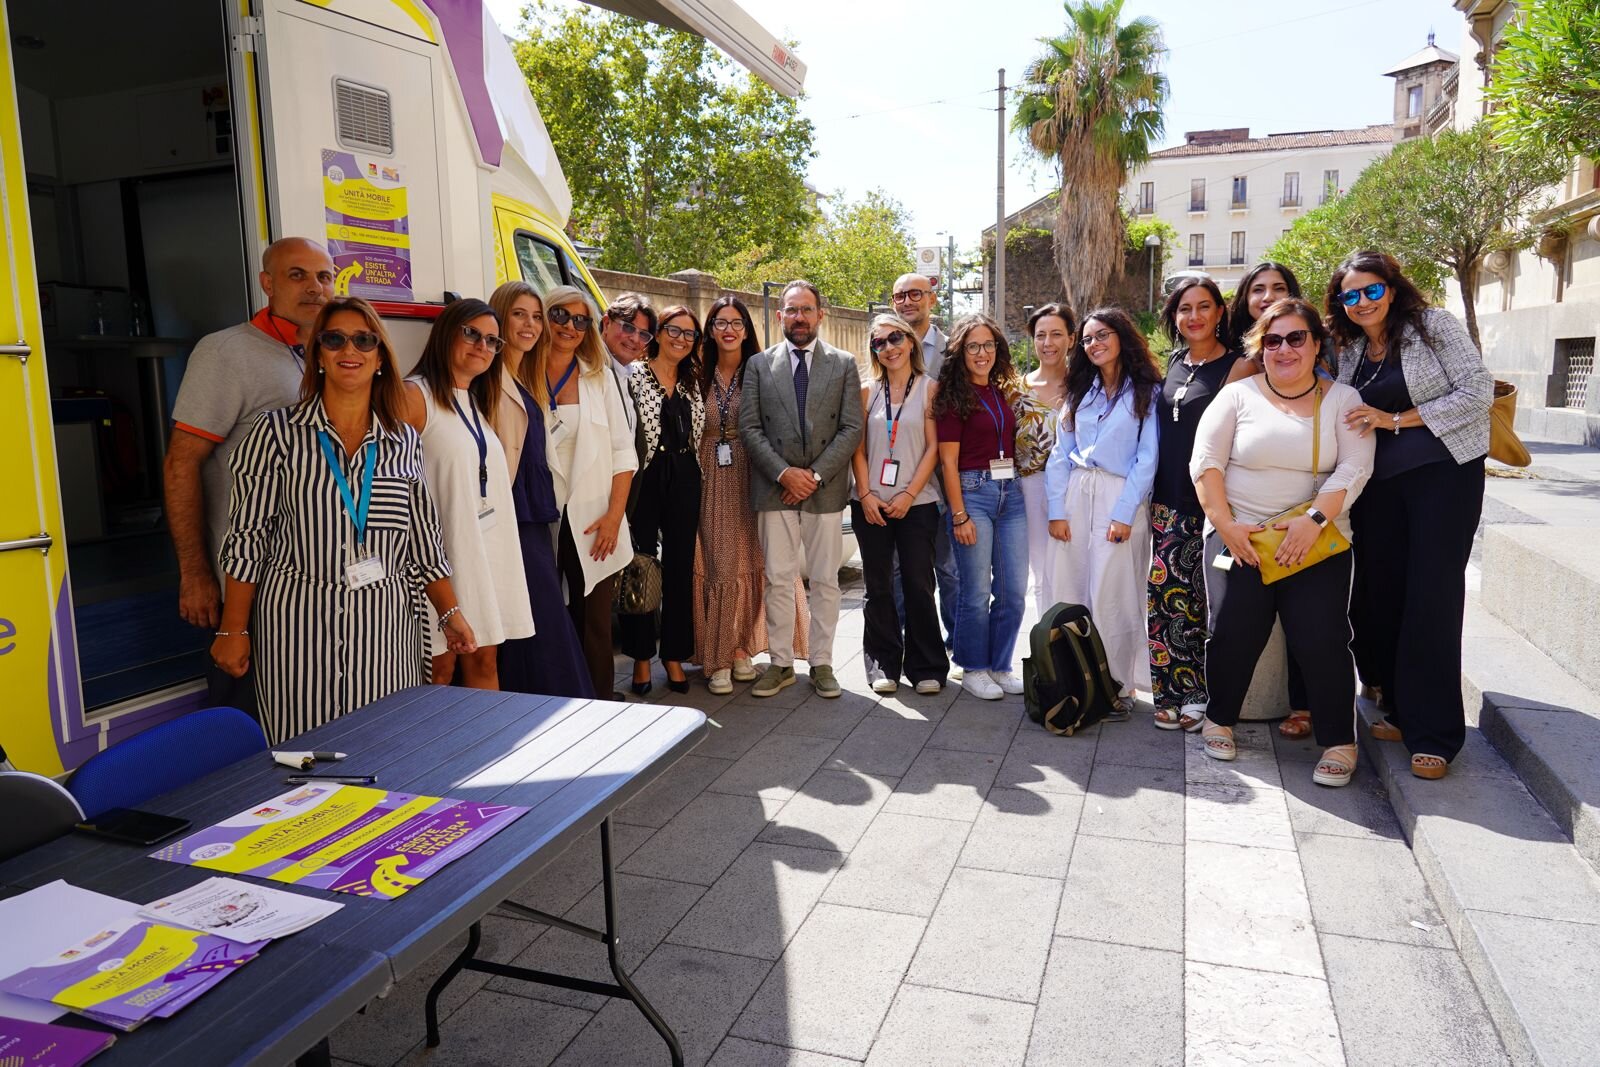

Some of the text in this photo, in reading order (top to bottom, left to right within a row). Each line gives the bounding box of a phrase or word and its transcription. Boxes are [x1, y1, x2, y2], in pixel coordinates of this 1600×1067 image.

[366, 193, 391, 203] MOBILE
[365, 261, 386, 270] ESISTE
[365, 269, 396, 279] UN'ALTRA
[365, 276, 392, 285] STRADA
[293, 803, 343, 828] MOBILE
[395, 828, 441, 852] ESISTE
[407, 820, 470, 854] UN'ALTRA
[420, 827, 473, 856] STRADA
